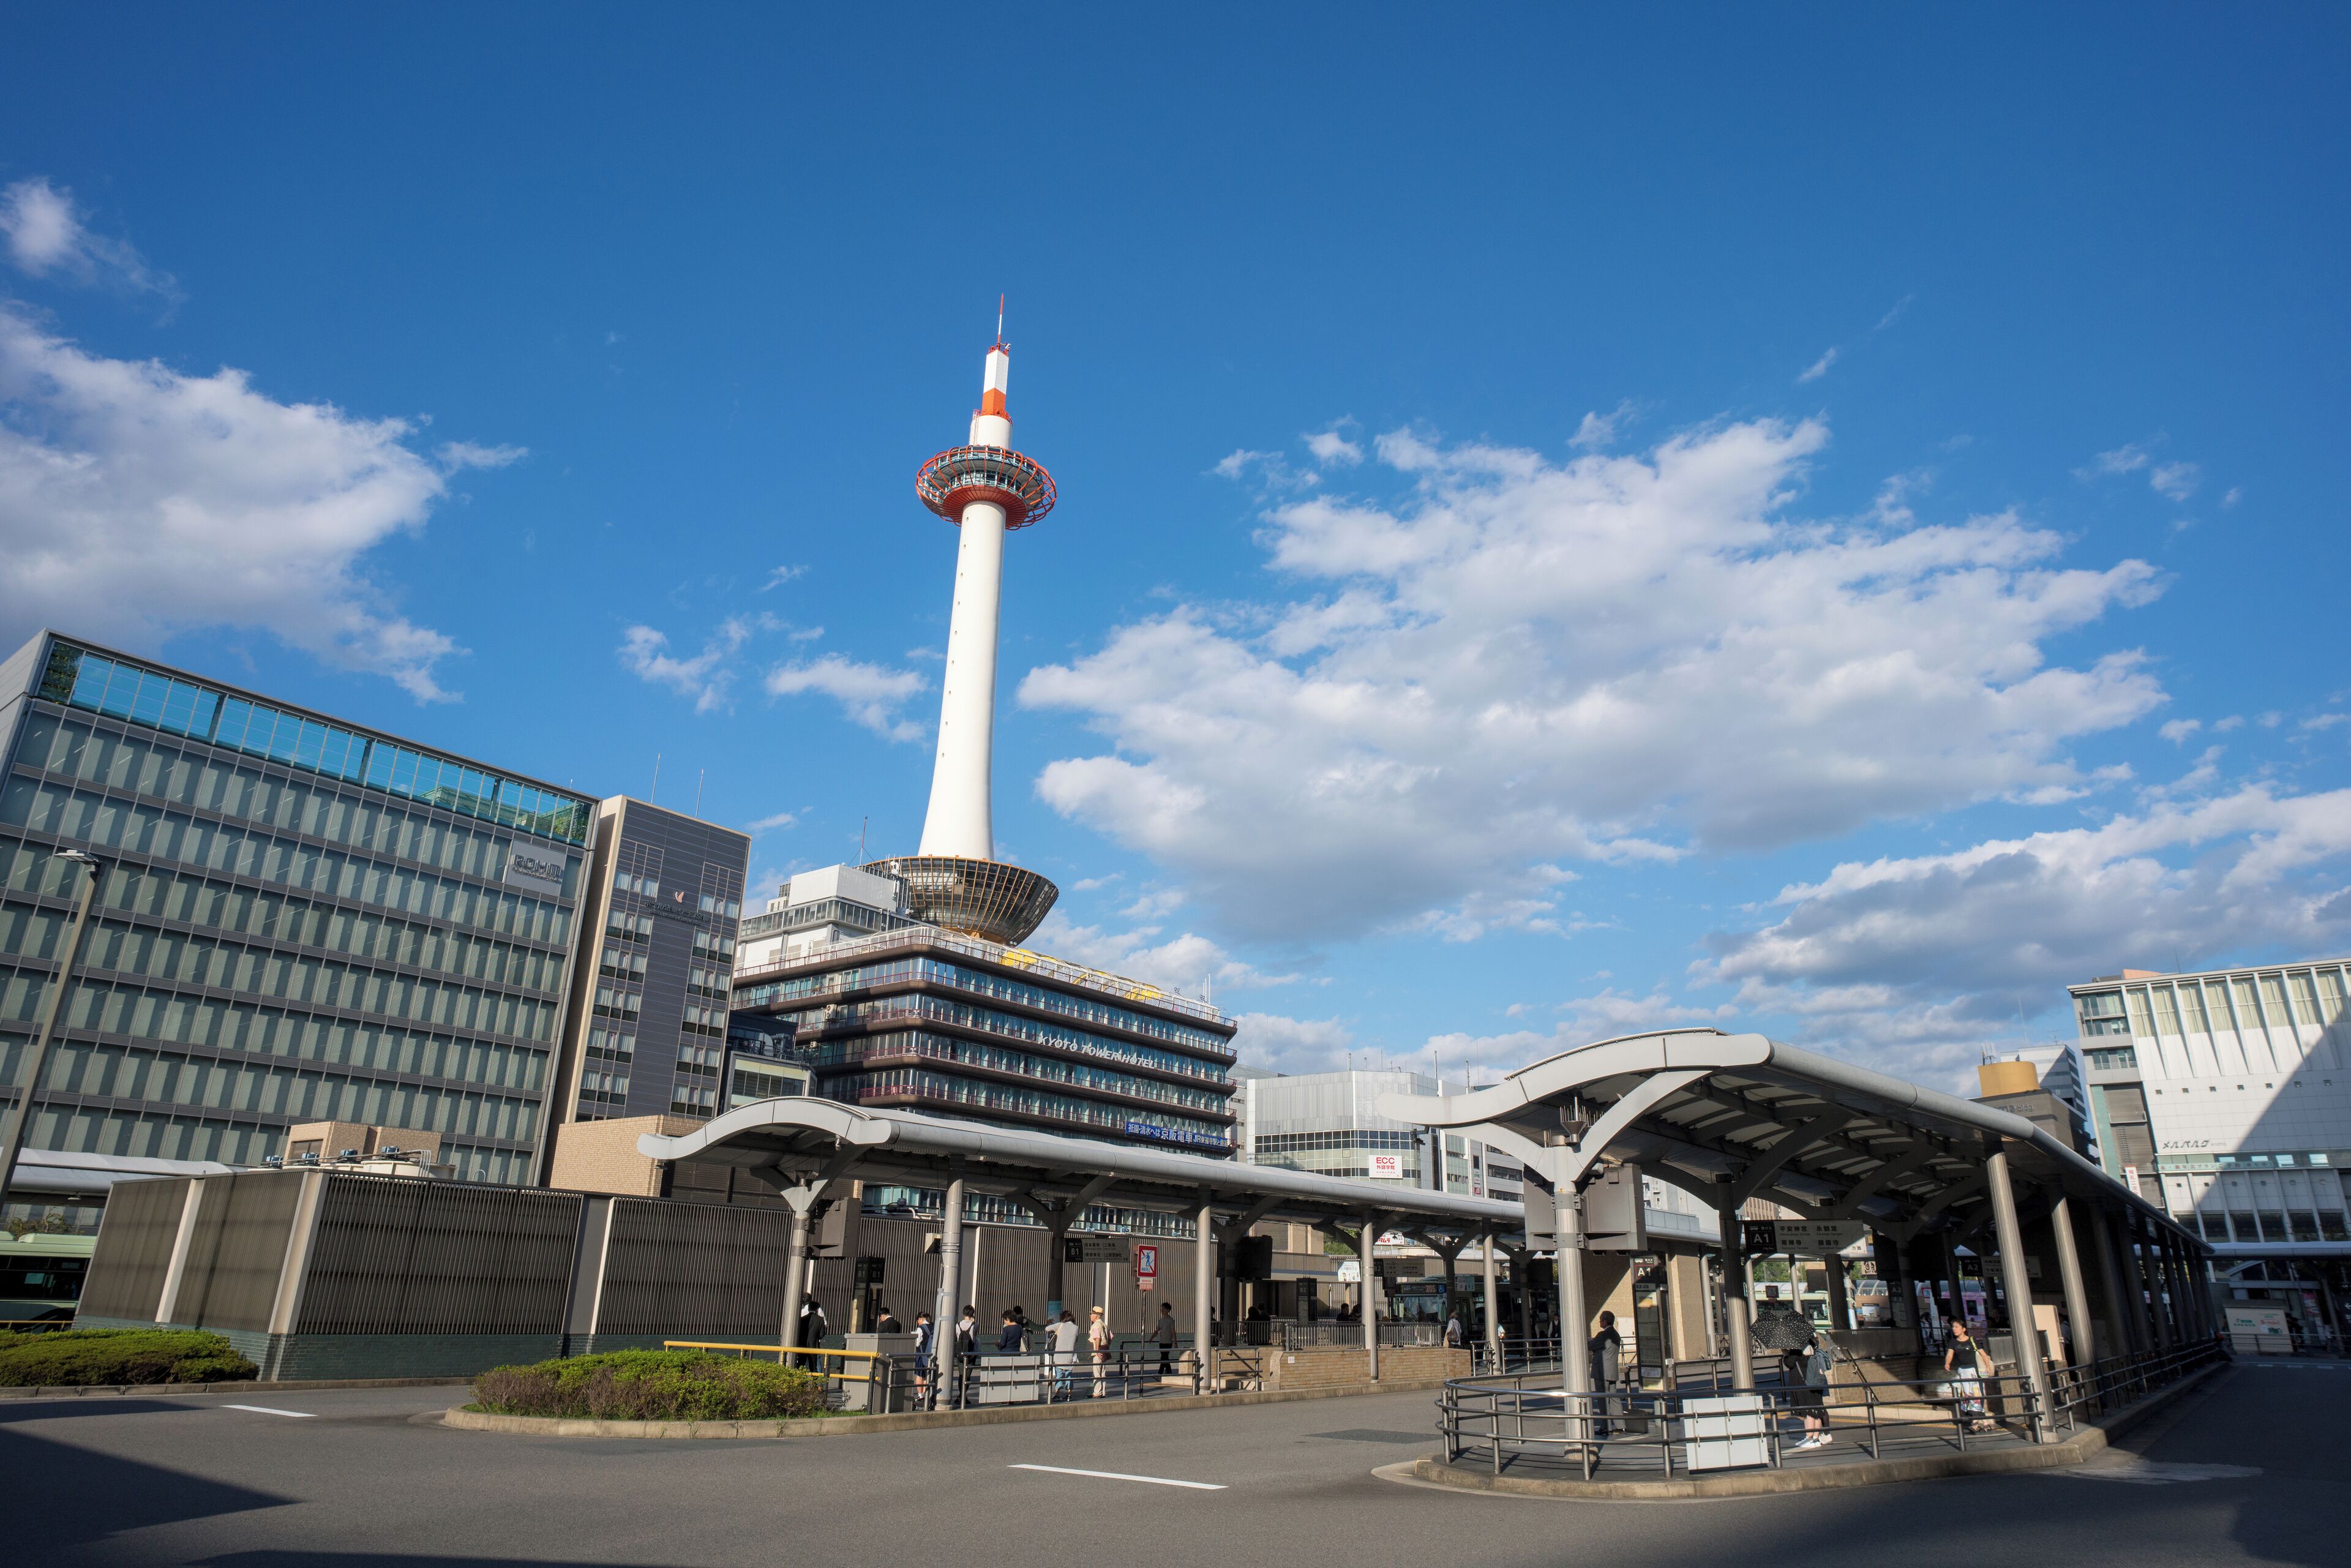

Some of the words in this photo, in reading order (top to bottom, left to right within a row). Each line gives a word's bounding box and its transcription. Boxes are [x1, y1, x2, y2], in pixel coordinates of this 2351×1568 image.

[512, 854, 564, 880] ROHM
[1038, 1037, 1078, 1052] KYOTO
[1082, 1045, 1118, 1061] TOWER
[1121, 1054, 1155, 1068] HOTEL
[1161, 1128, 1193, 1143] 京阪電車
[2162, 1140, 2210, 1149] メルパルク
[1753, 1233, 1769, 1243] A1
[1637, 1267, 1651, 1277] A1
